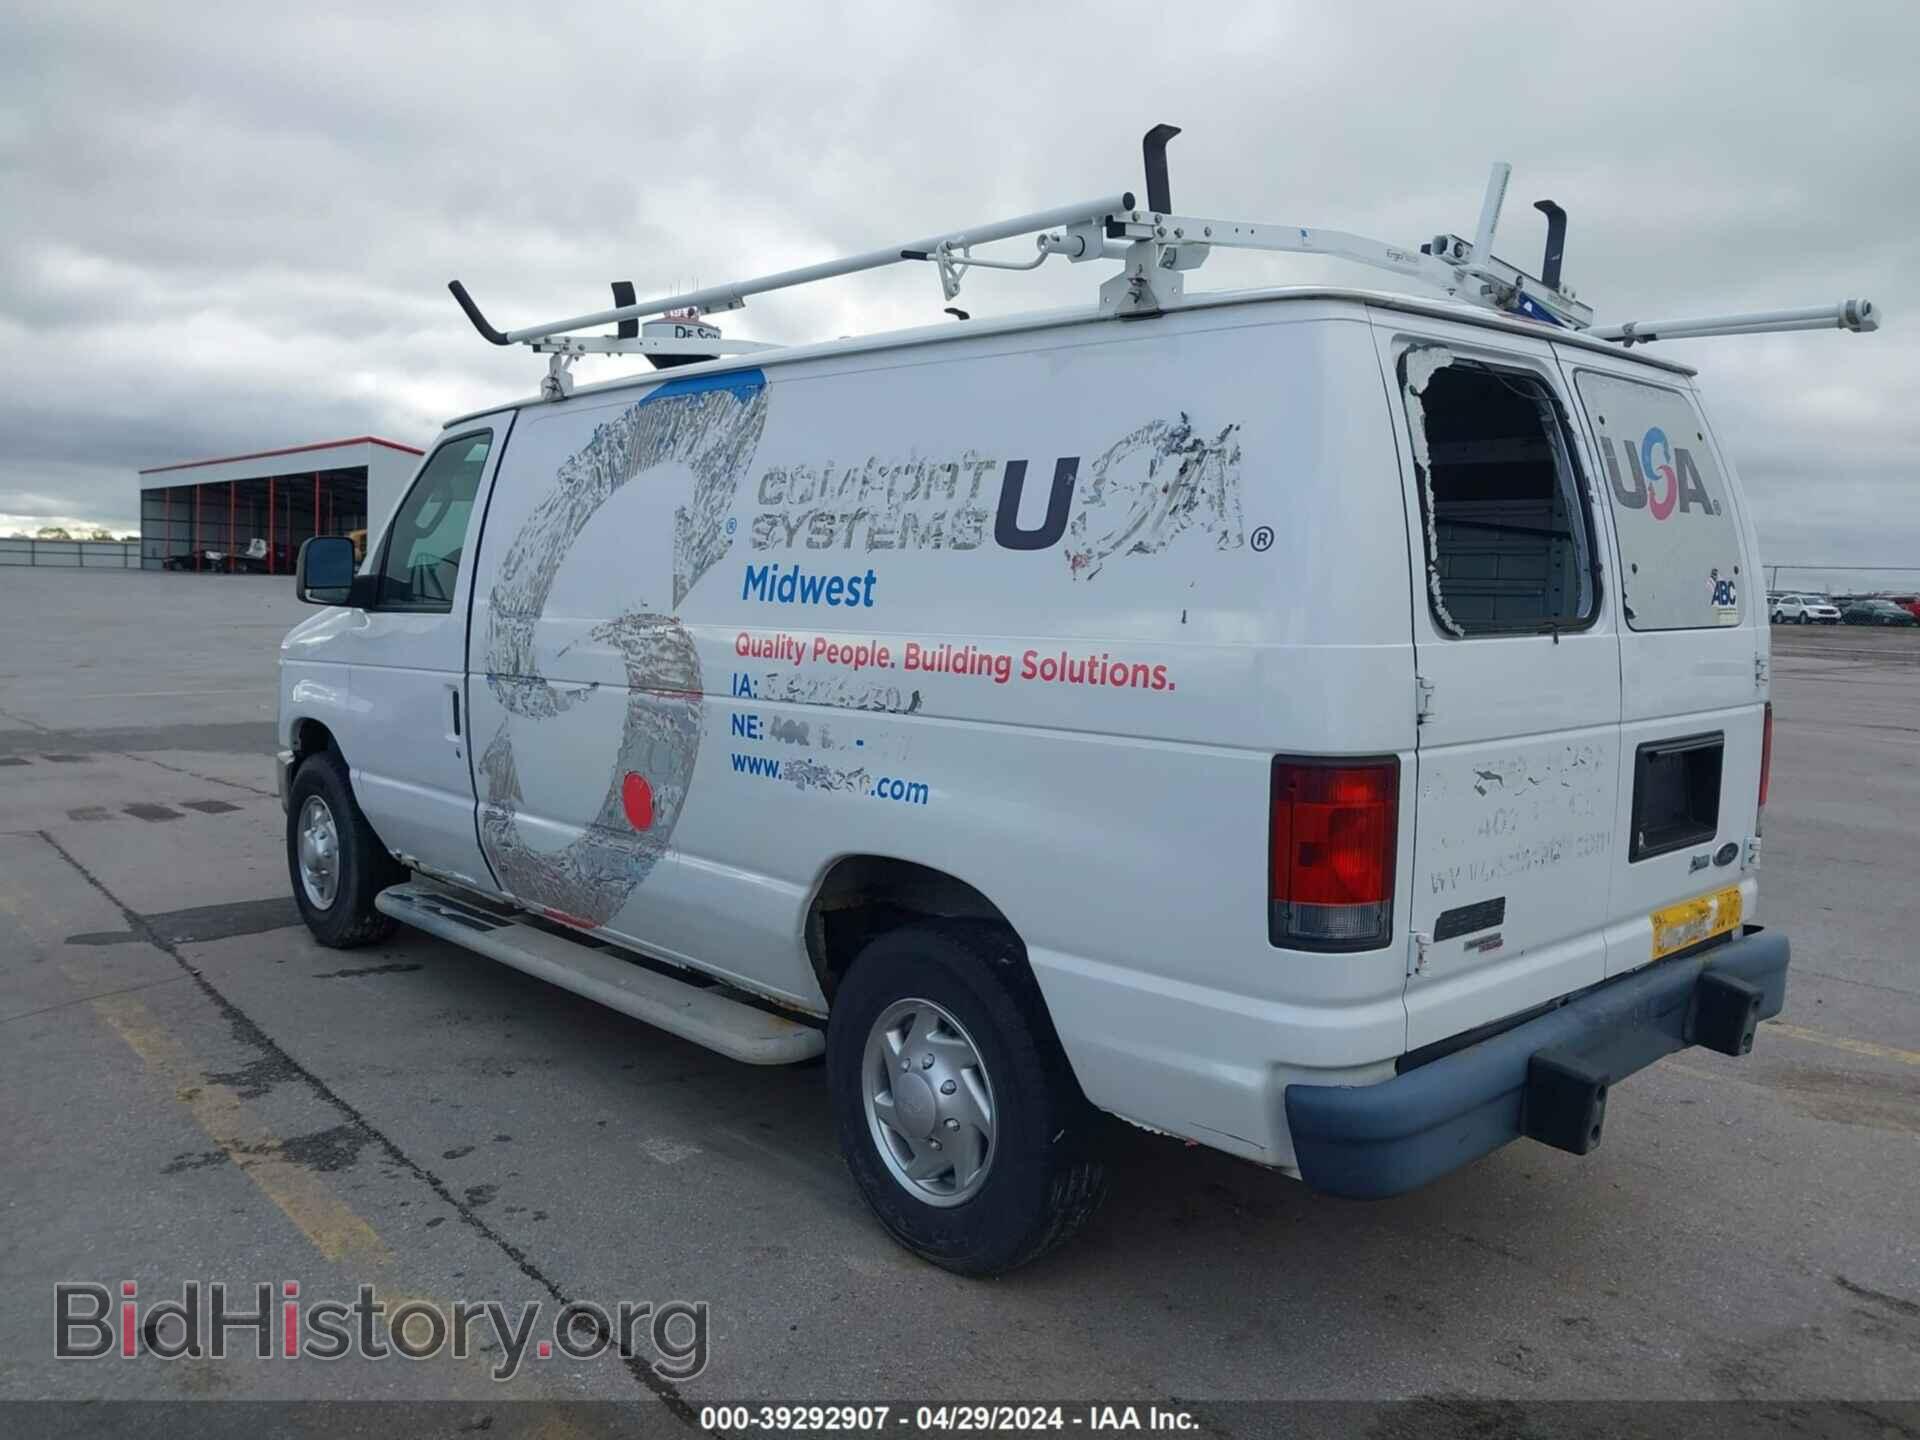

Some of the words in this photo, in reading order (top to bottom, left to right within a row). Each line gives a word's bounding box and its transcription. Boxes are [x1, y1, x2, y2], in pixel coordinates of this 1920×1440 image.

[742, 564, 877, 608] Midwest
[1711, 580, 1737, 606] ABC
[735, 631, 807, 666] Quality
[812, 637, 895, 671] People.
[904, 642, 1012, 684] Building
[1021, 650, 1176, 691] Solutions.
[732, 673, 759, 698] IA:
[731, 713, 764, 740] NE:
